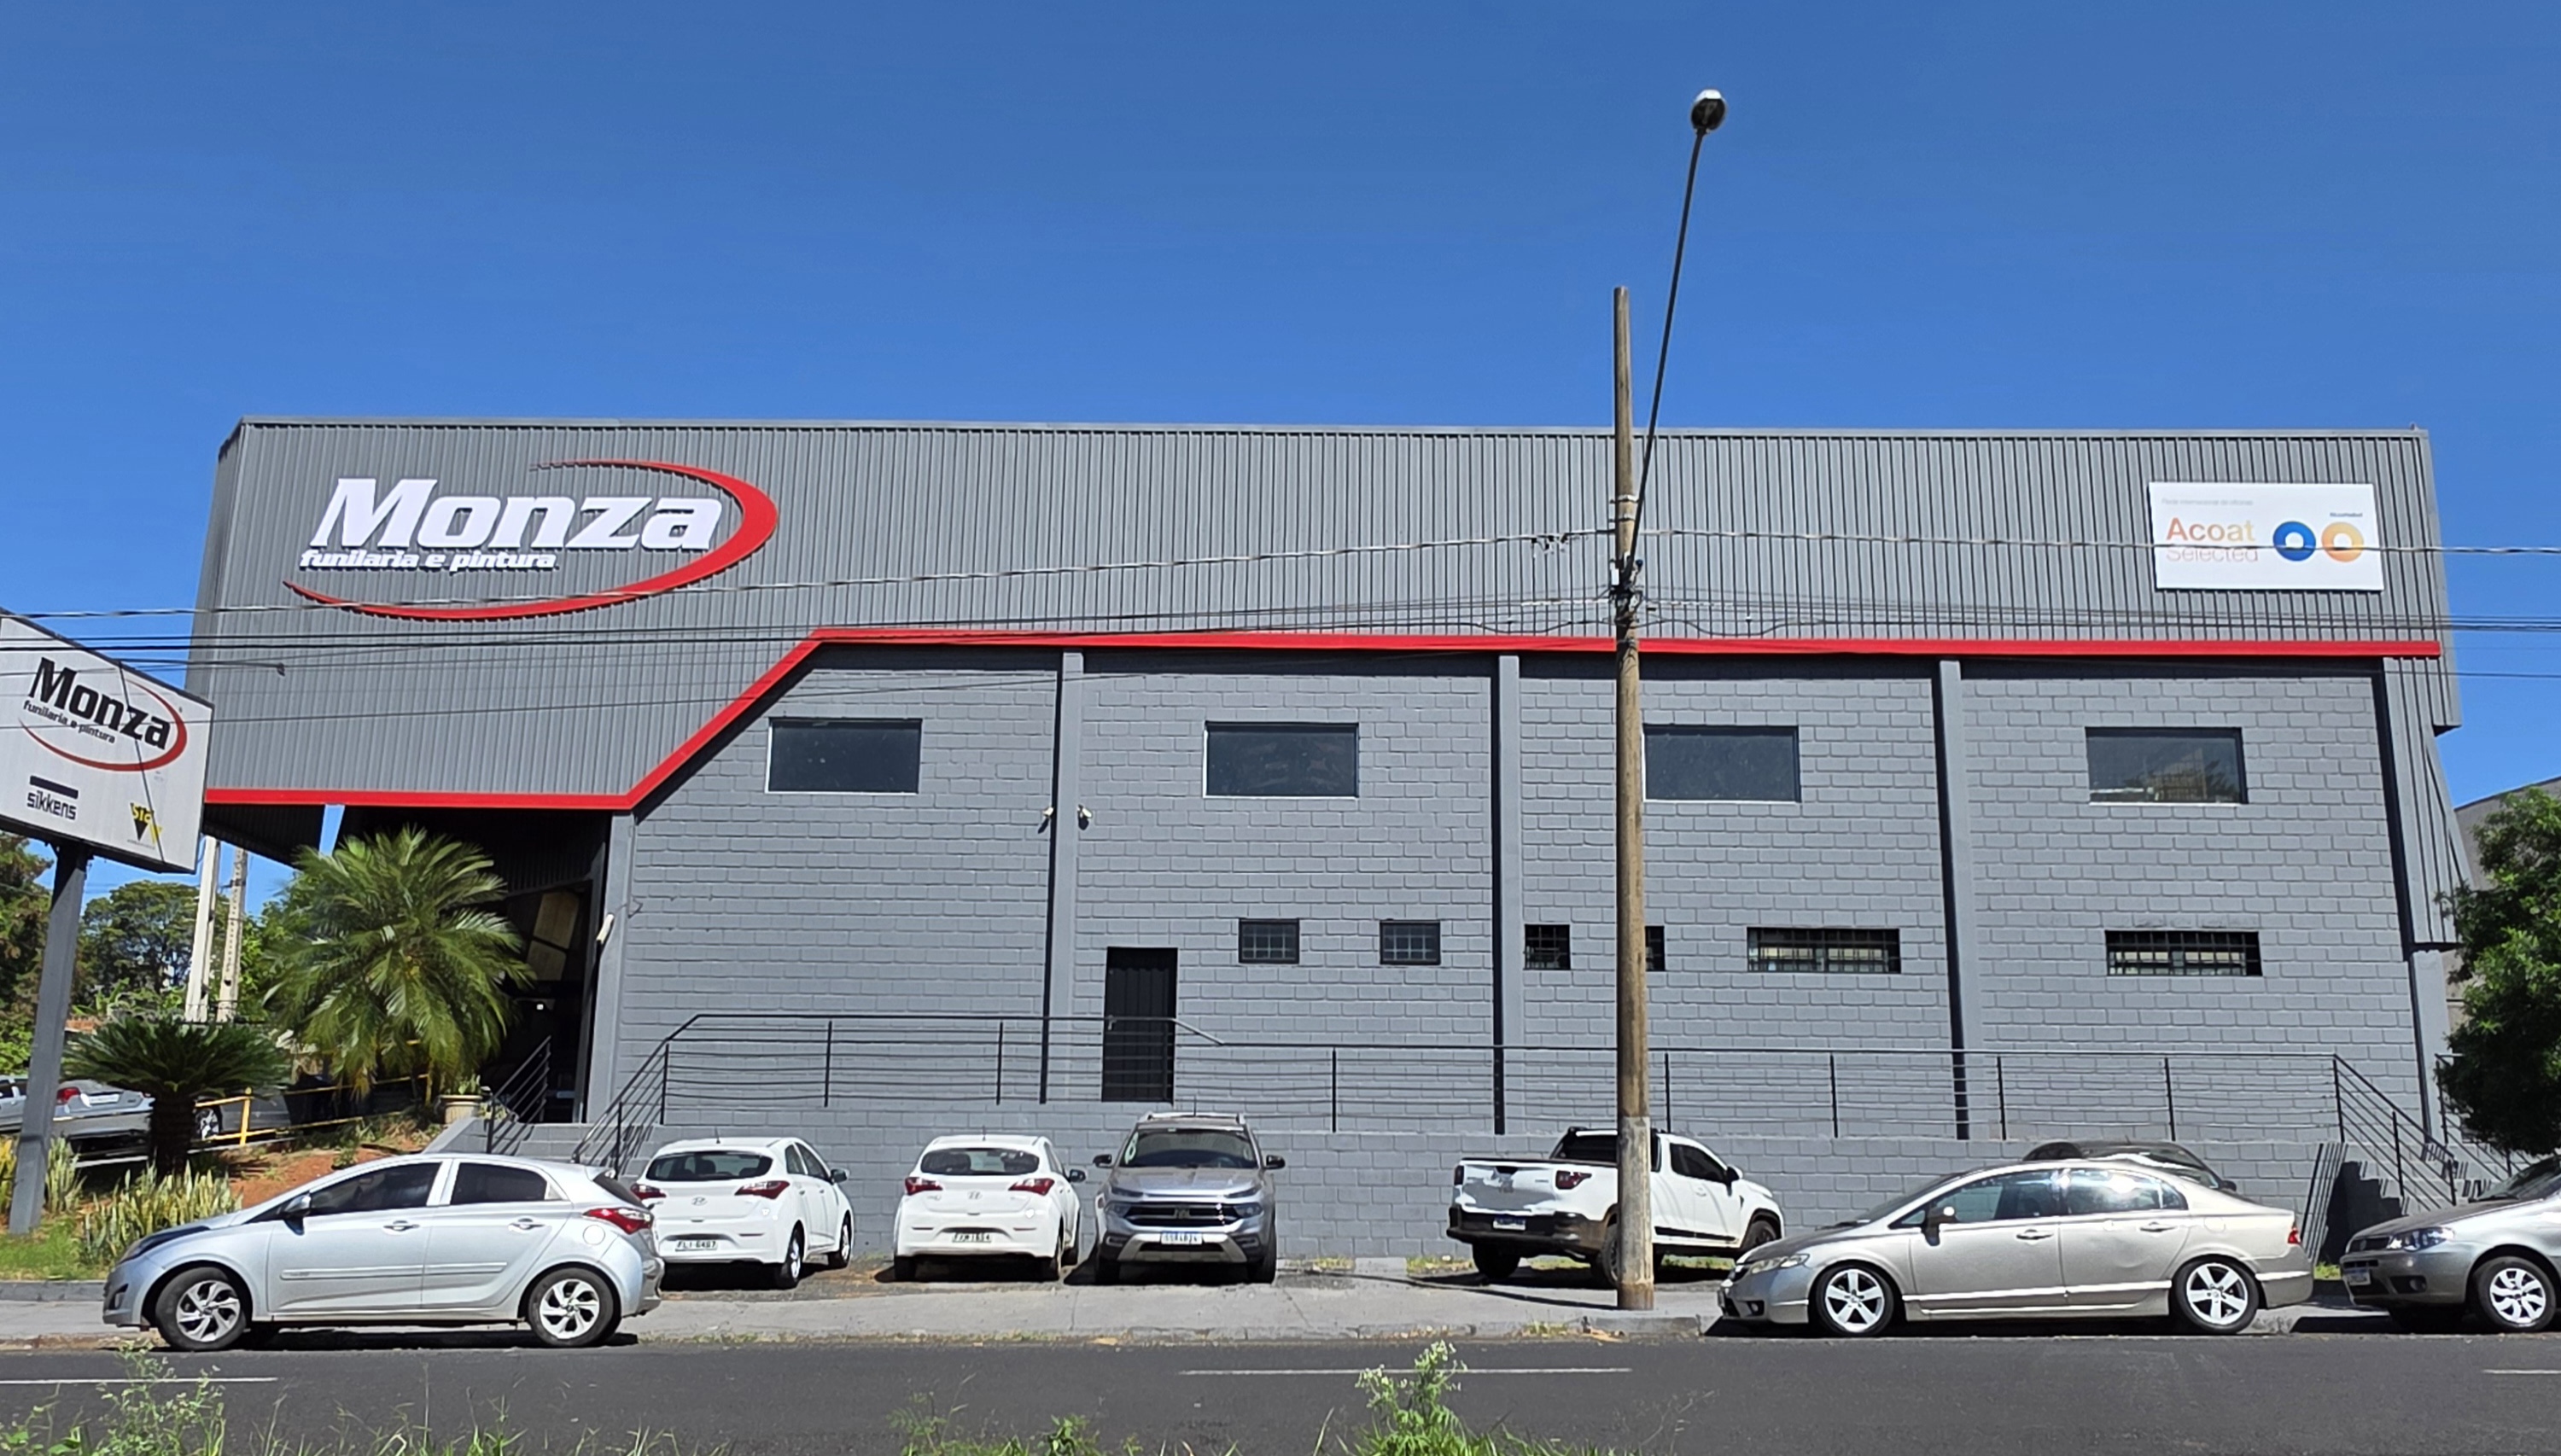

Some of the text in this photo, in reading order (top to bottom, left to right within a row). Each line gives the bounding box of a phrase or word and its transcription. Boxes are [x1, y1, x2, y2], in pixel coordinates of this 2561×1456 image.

[309, 478, 723, 549] Monza
[2166, 516, 2256, 542] Acoat
[299, 549, 557, 572] funilaria e pintura
[2166, 545, 2259, 563] Selected
[28, 656, 172, 749] Monza
[23, 700, 115, 744] funilaria e pintura
[26, 789, 77, 820] sikkens
